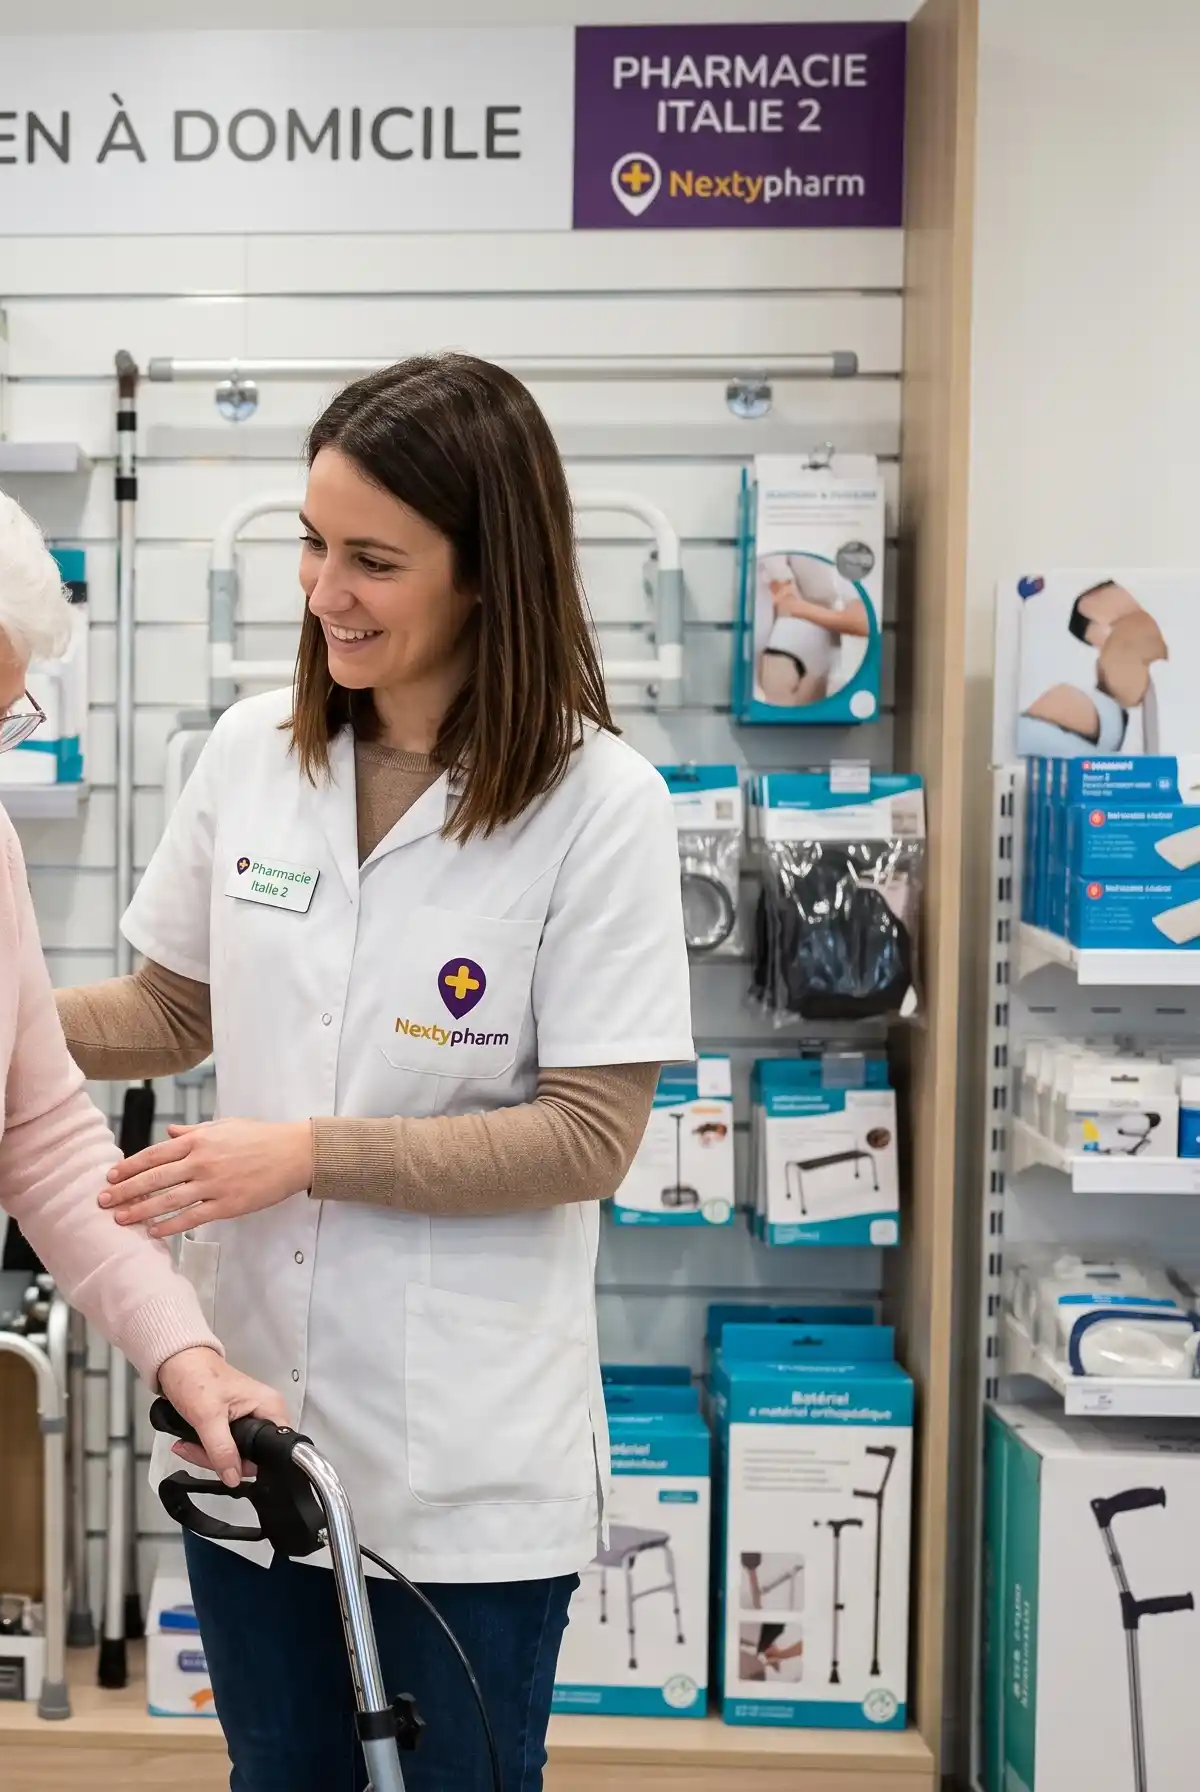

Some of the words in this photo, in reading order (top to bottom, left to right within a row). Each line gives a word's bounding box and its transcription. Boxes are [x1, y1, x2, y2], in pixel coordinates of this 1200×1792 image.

[612, 53, 869, 90] PHARMACIE
[96, 92, 147, 165] À
[171, 105, 523, 163] DOMICILE
[656, 98, 785, 134] ITALIE
[796, 97, 822, 133] 2
[668, 165, 866, 205] Nextypharm
[251, 862, 312, 884] Pharmacie
[280, 886, 289, 898] 2
[394, 1016, 510, 1047] Nextypharm
